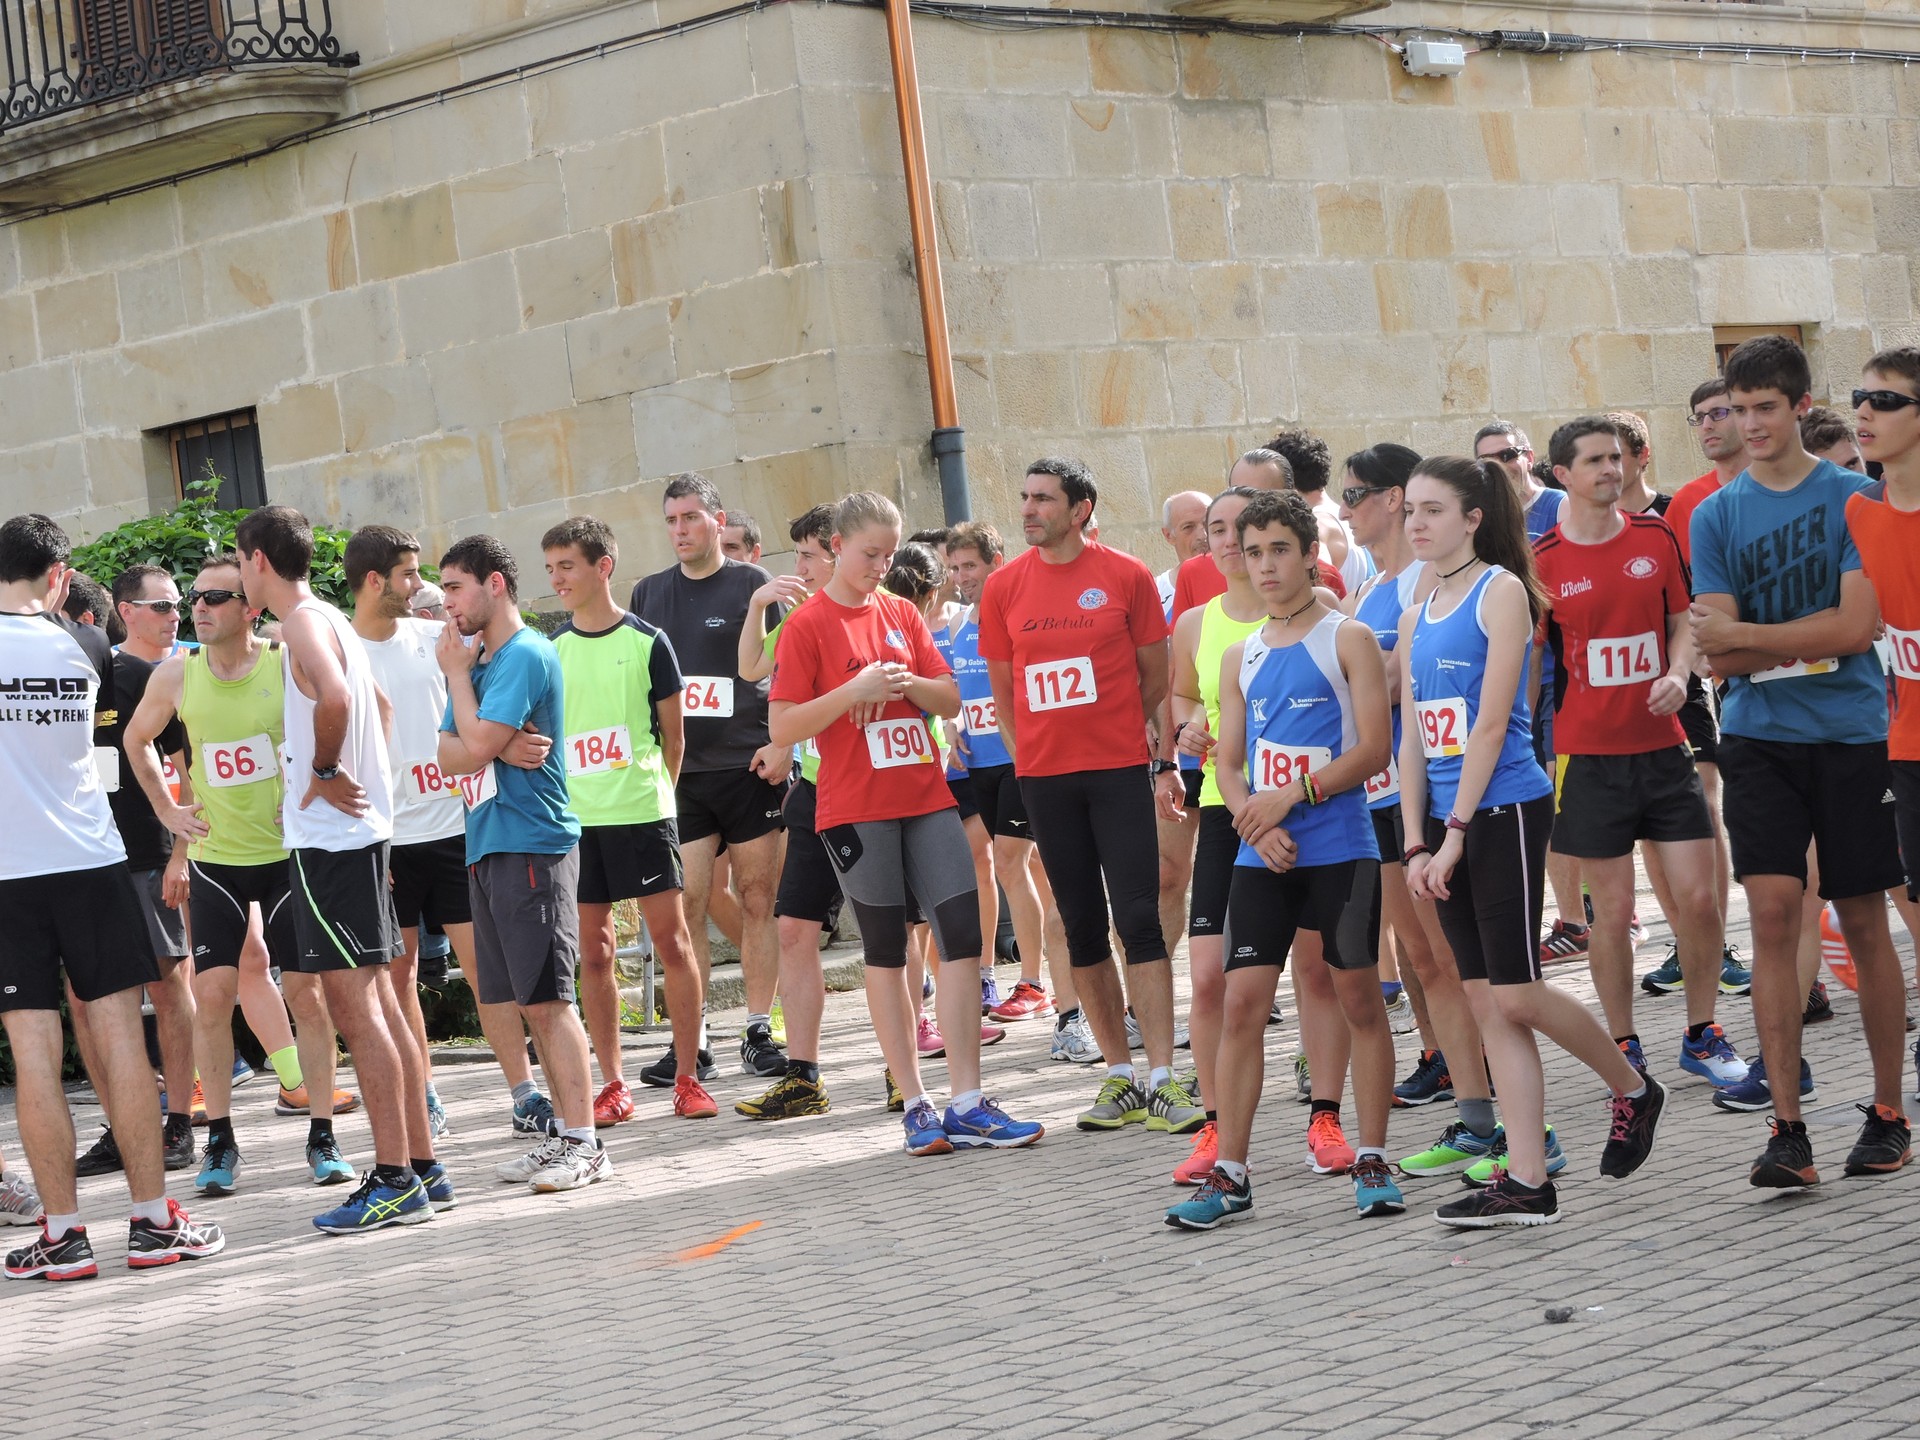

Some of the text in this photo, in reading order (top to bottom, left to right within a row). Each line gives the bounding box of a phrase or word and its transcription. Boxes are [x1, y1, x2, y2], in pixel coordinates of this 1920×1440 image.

[1739, 503, 1827, 591] NEVER
[1043, 615, 1094, 630] Betula
[1600, 642, 1651, 678] 114
[685, 682, 720, 710] 64
[1034, 667, 1087, 704] 112
[27, 709, 89, 726] EXTREME
[965, 702, 998, 730] 123
[1418, 707, 1458, 749] 192
[574, 731, 623, 768] 184
[876, 724, 925, 759] 190
[215, 745, 255, 779] 66
[1262, 748, 1309, 788] 181
